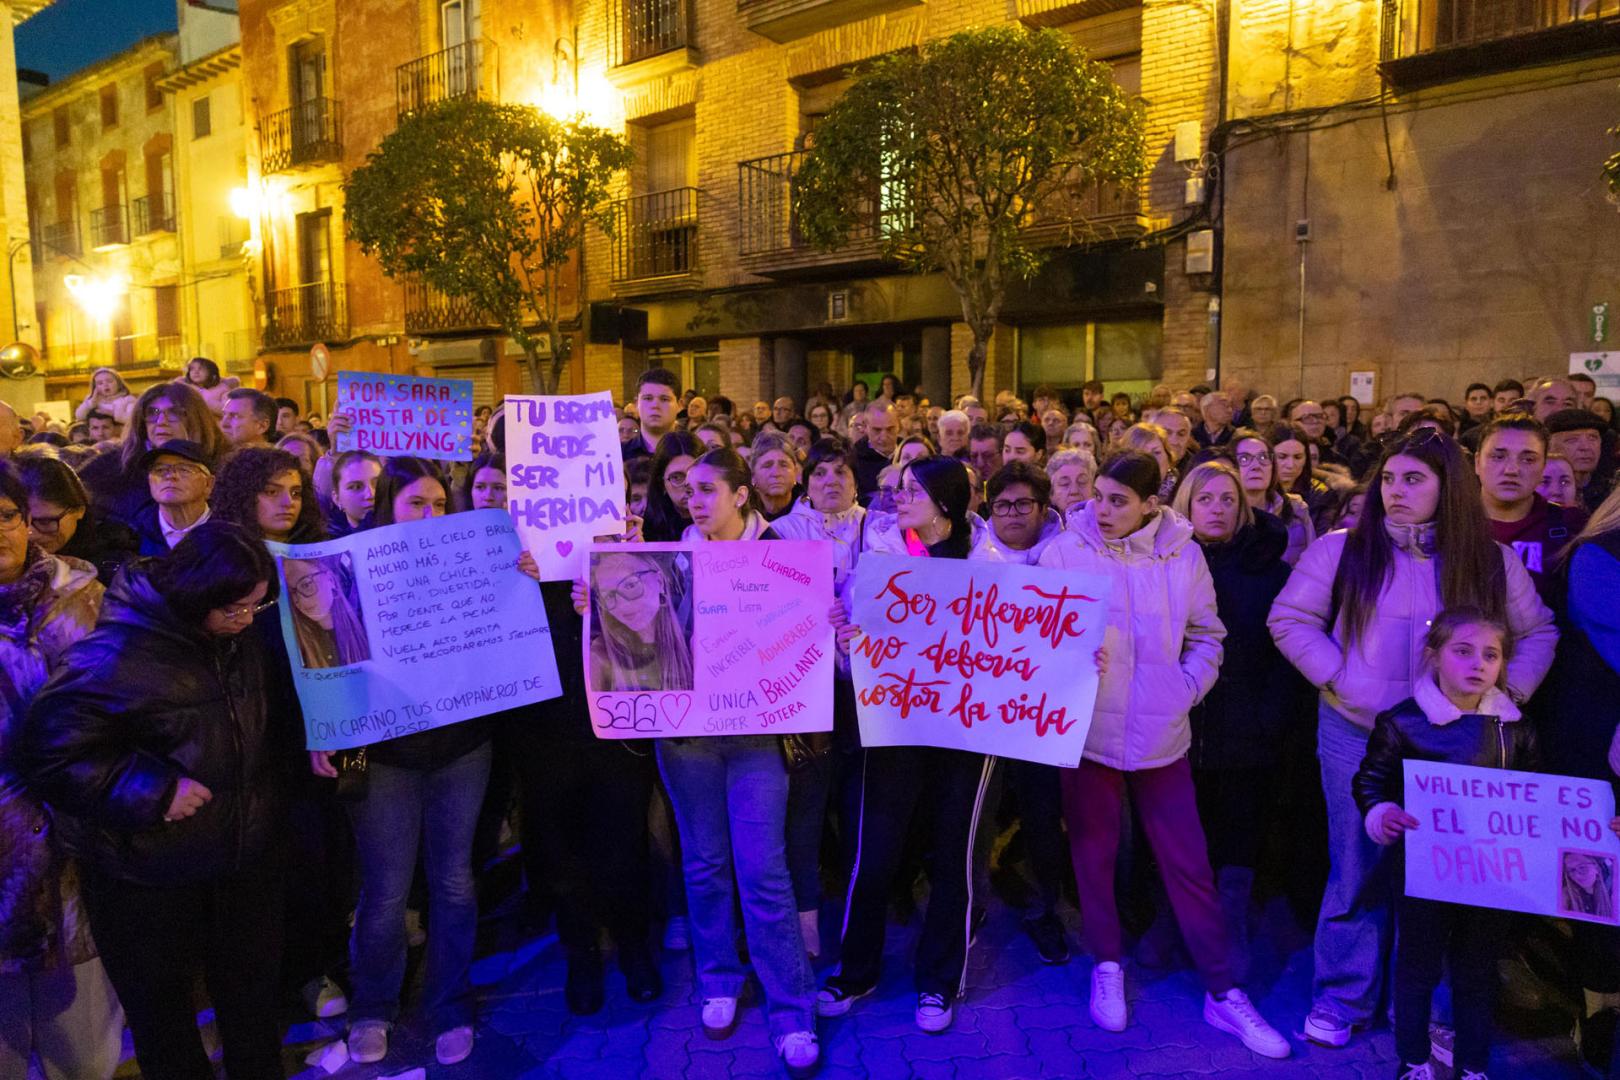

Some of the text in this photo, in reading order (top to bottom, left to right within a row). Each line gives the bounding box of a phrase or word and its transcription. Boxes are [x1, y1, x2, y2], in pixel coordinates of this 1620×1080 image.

[350, 381, 388, 403] POR
[345, 406, 451, 427] BASTA DE
[505, 398, 547, 428] TU
[357, 429, 455, 452] BULLYING
[531, 432, 597, 460] PUEDE
[510, 463, 560, 490] SER
[510, 493, 621, 531] HERIDA
[366, 539, 409, 561] AHORA
[418, 536, 435, 550] EL
[440, 529, 476, 546] CIELO
[368, 559, 409, 580] MUCHO
[455, 551, 473, 565] SE
[486, 545, 504, 557] HA
[760, 544, 813, 587] LUCHADORA
[372, 580, 395, 594] IDO
[406, 575, 431, 589] UNA
[729, 578, 771, 593] VALIENTE
[377, 592, 497, 624] POR GENTE QUE NO
[696, 600, 729, 616] GUAPA
[875, 570, 1099, 650] Ser diferente
[381, 620, 433, 640] MERECE
[440, 614, 457, 626] LA
[381, 622, 501, 659] VUELA ALTO SARITA
[757, 614, 818, 664] ADMIRABLE
[399, 656, 419, 667] TE
[422, 635, 504, 661] RECORDAREMOS
[854, 630, 1041, 682] no debería
[758, 642, 825, 705] BRILLANTE
[309, 675, 545, 741] CON CARIÑO TUS COMPAÑEROS DE
[596, 693, 663, 732] Sara
[756, 700, 807, 729] JOTERA
[858, 668, 1078, 737] costar la vida
[1415, 774, 1593, 809] VALIENTE ES
[1431, 808, 1602, 843] EL QUE NO
[1431, 837, 1529, 884] DAÑA
